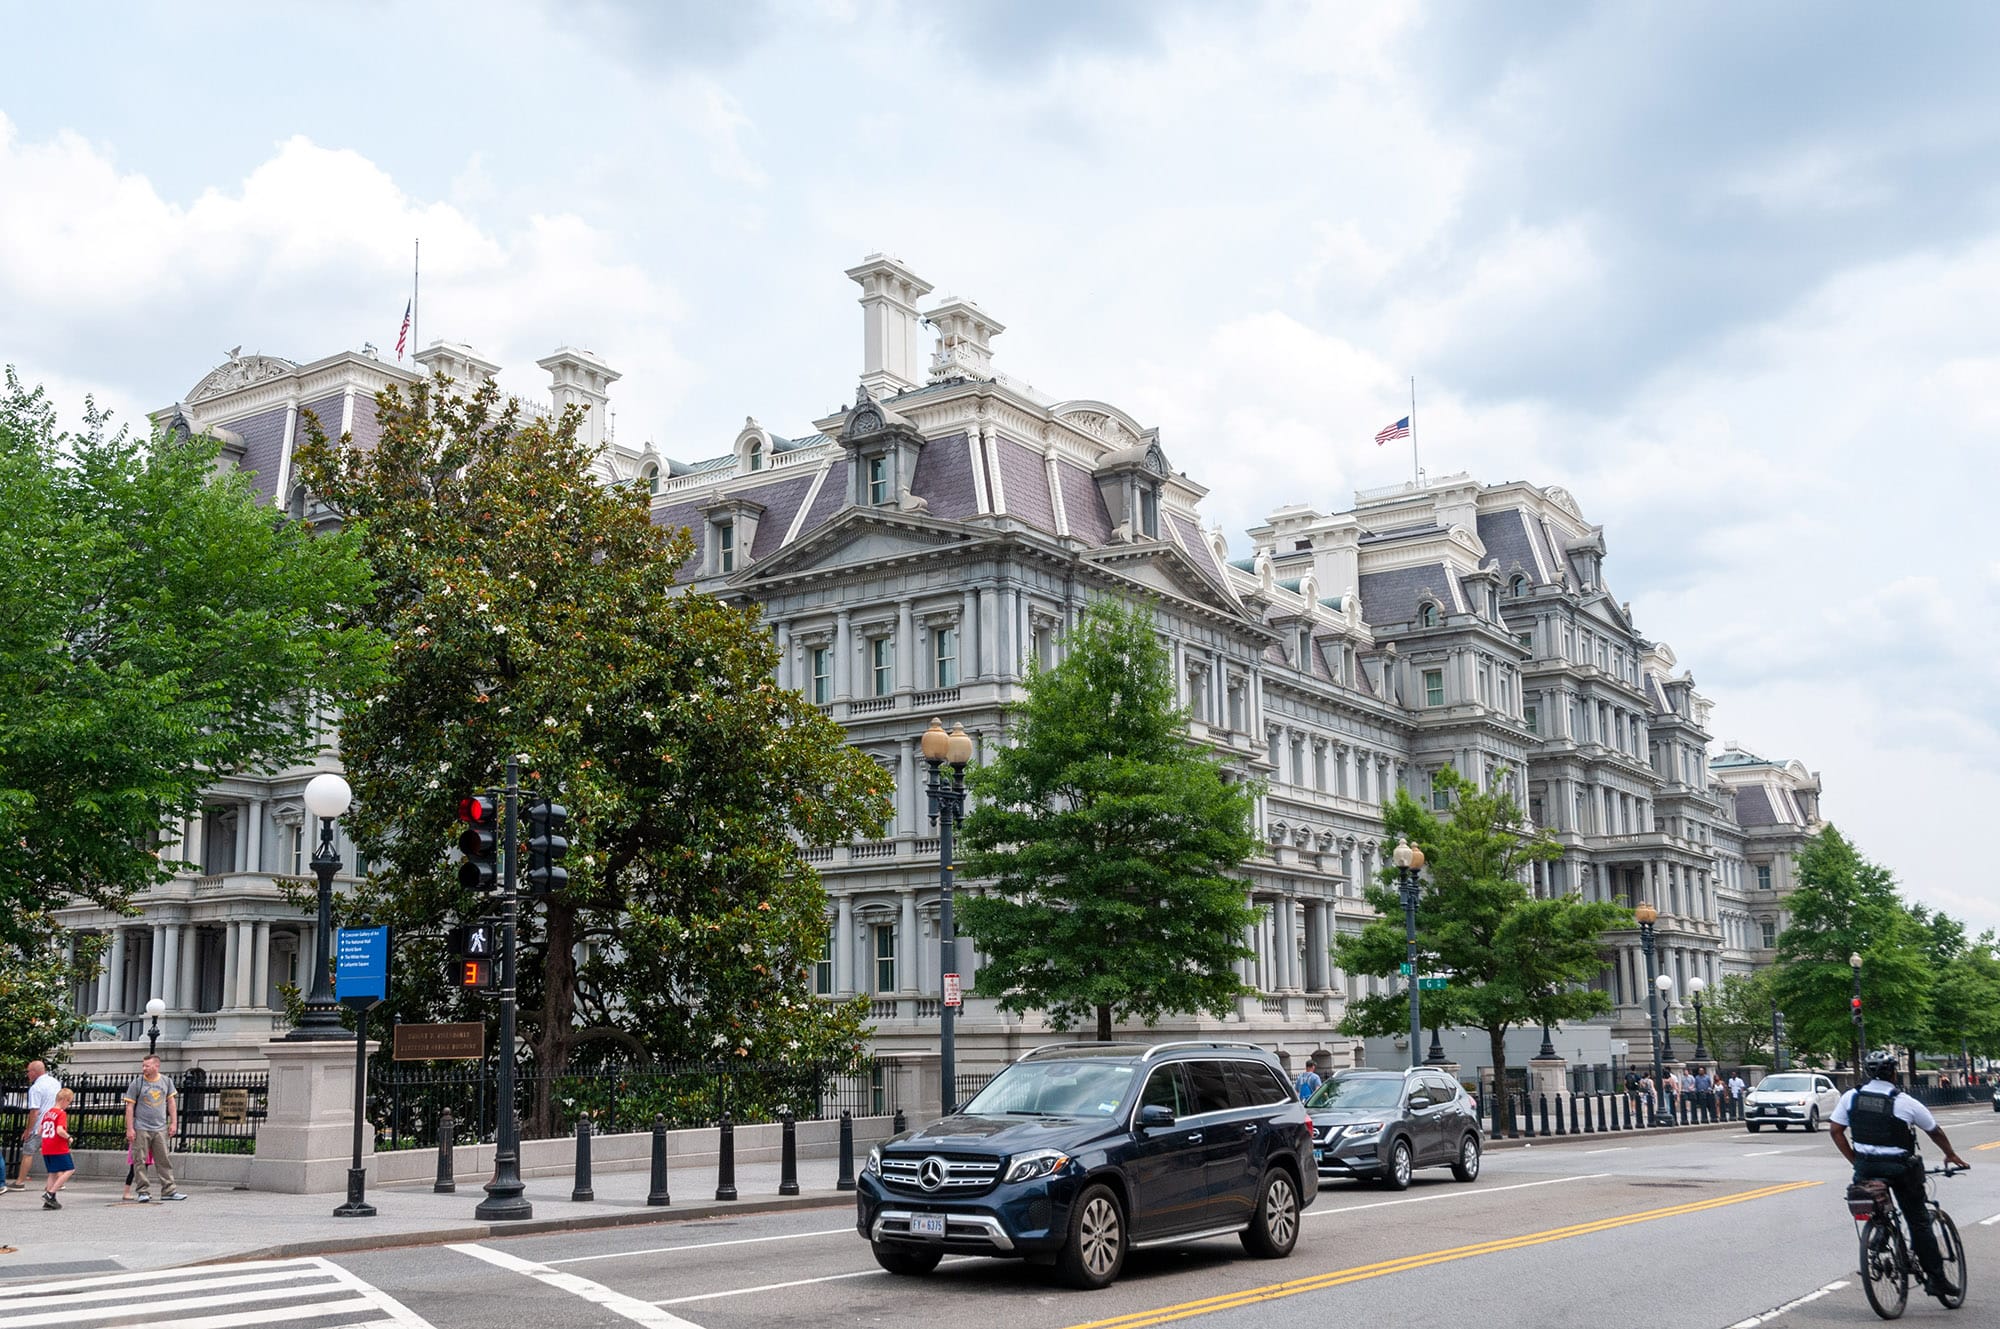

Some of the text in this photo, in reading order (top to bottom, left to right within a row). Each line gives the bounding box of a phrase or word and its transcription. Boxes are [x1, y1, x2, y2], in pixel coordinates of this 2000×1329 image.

[465, 963, 477, 984] 3
[1426, 979, 1432, 988] G
[42, 1121, 56, 1138] 23
